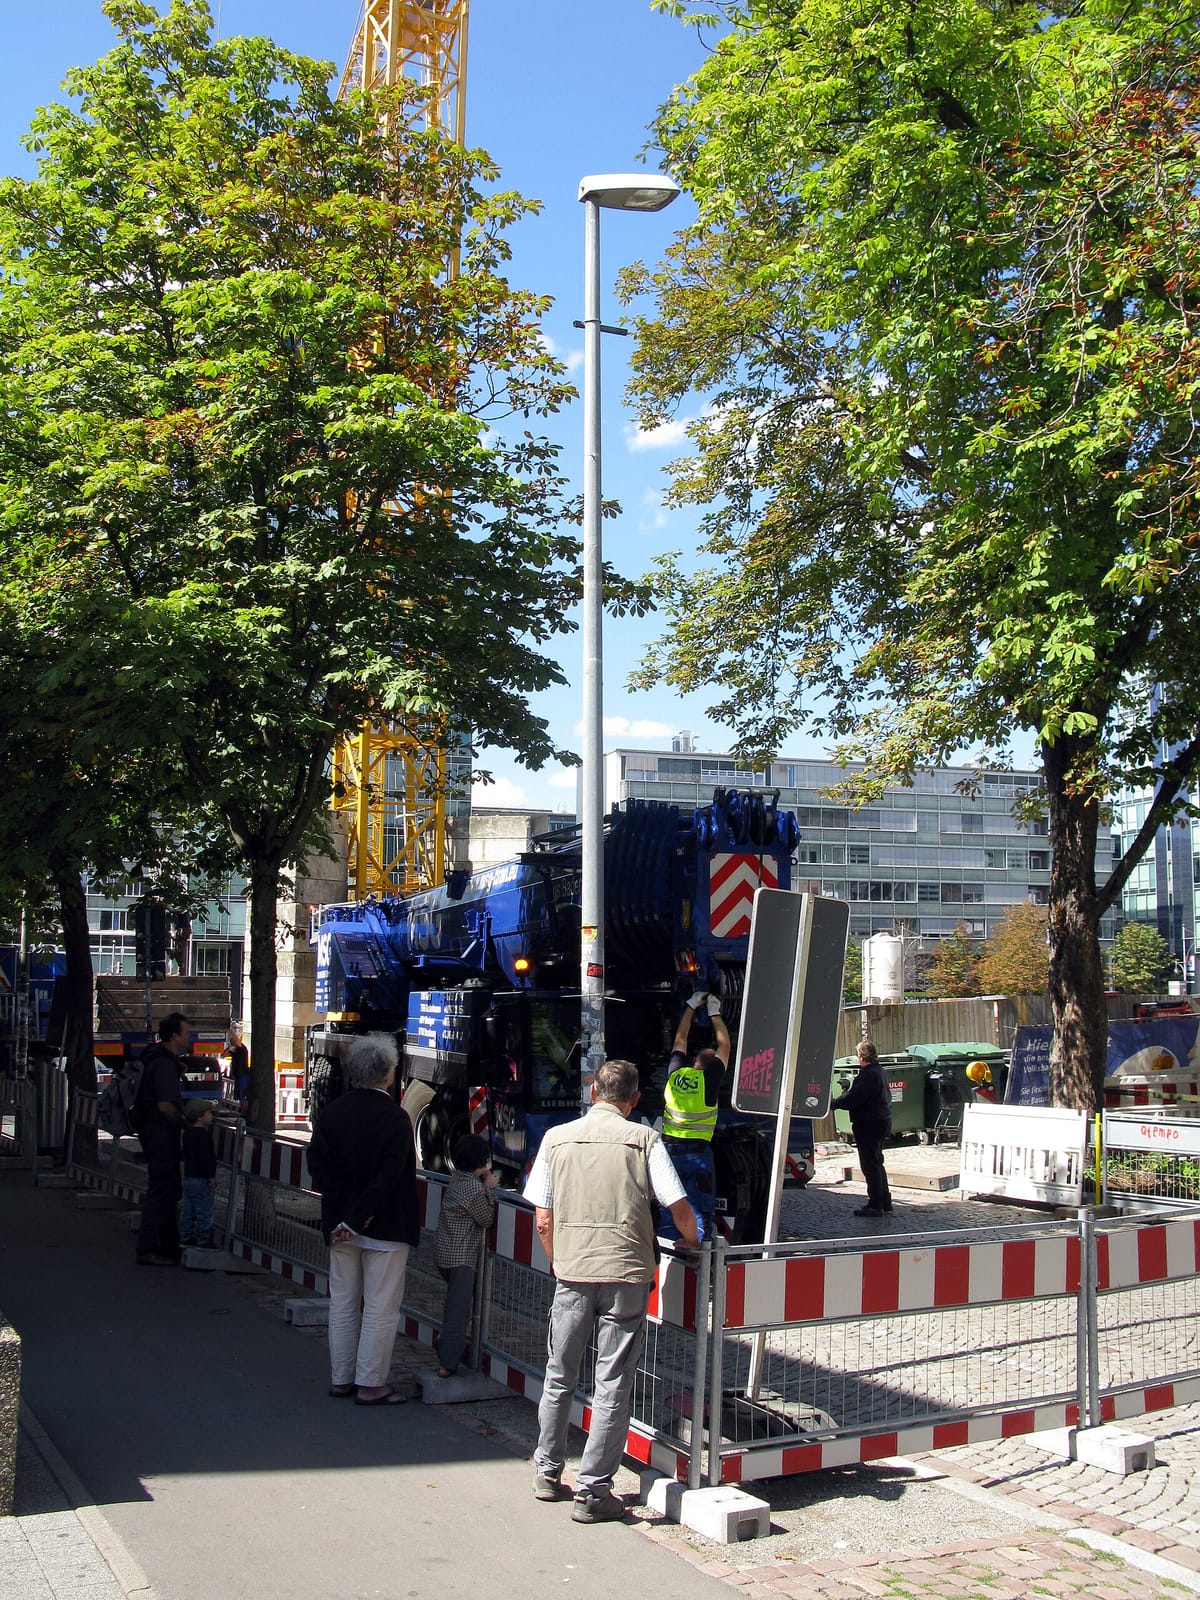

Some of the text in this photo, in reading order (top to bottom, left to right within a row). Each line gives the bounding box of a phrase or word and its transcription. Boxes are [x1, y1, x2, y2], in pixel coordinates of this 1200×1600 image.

[741, 1047, 775, 1077] BMS
[1023, 1064, 1049, 1074] Volksba
[739, 1062, 773, 1092] MIETE
[541, 1100, 581, 1108] LIEBHE
